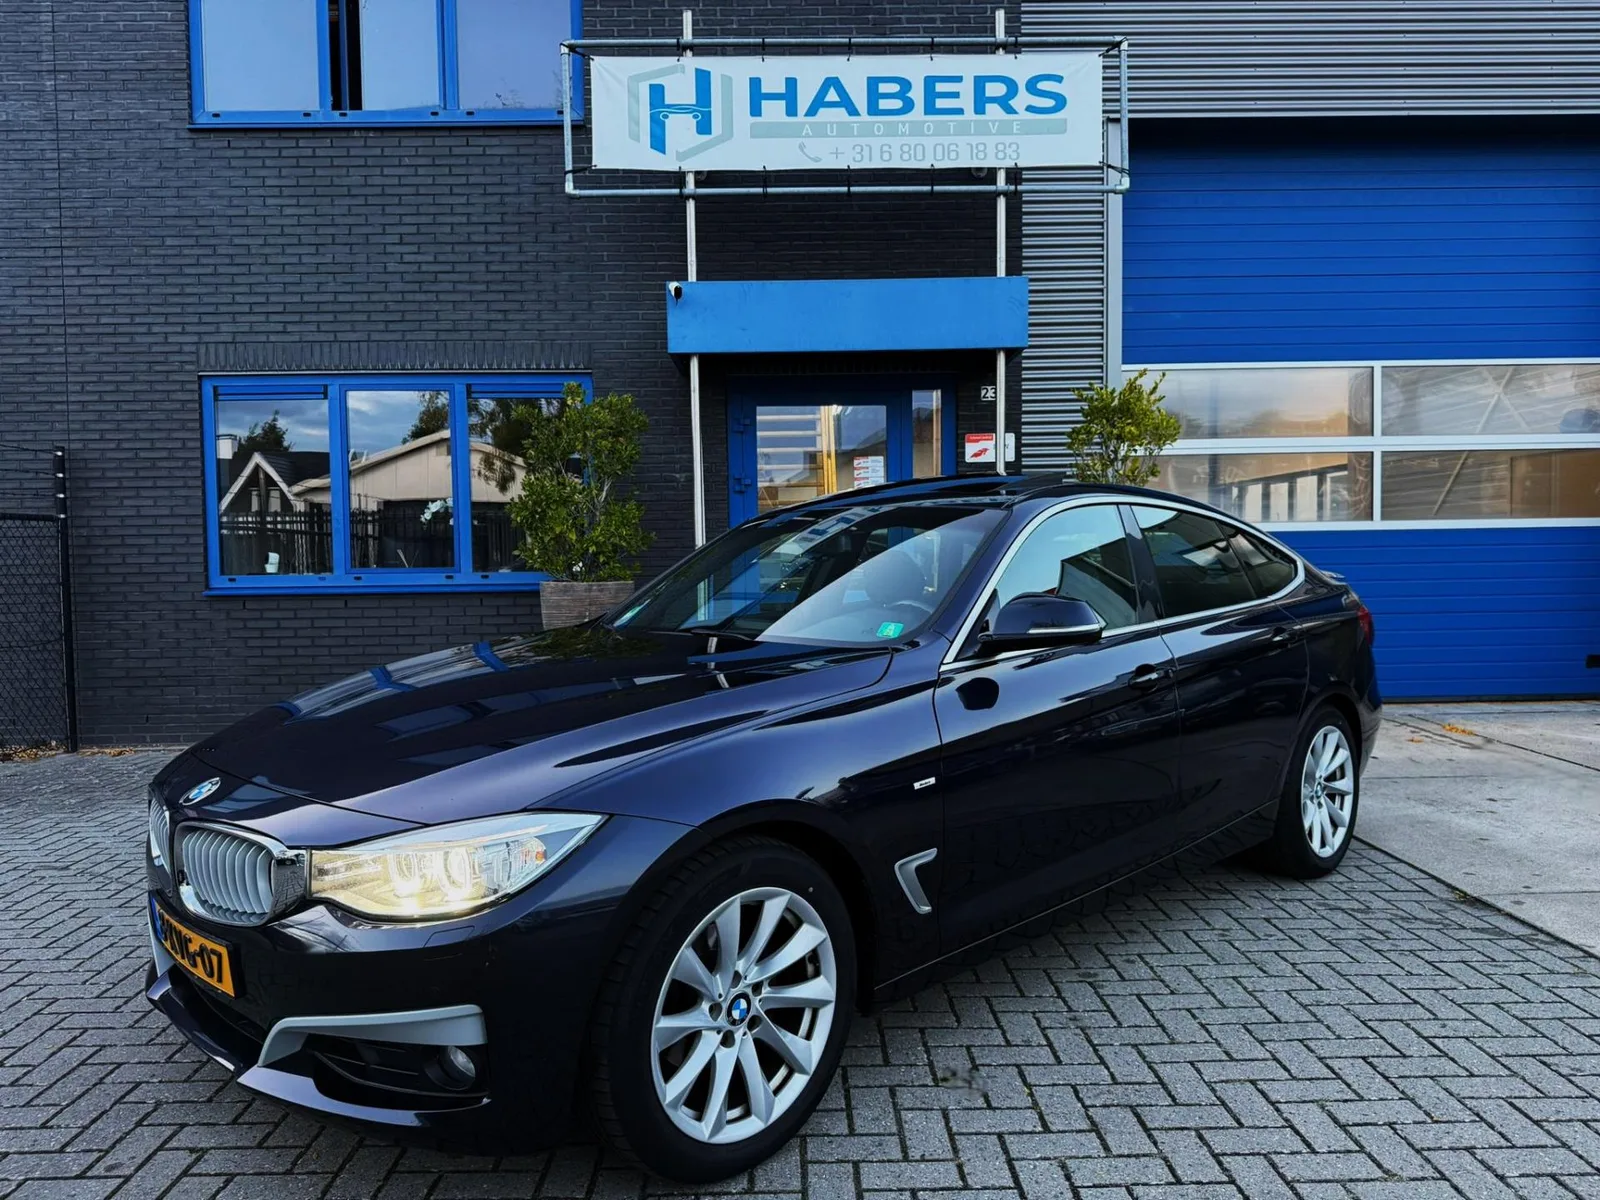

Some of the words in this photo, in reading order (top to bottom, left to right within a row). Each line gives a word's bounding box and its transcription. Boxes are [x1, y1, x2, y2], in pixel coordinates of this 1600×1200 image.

[749, 73, 1068, 117] HABERS
[802, 121, 1021, 136] AUTOMOTIVE
[879, 143, 893, 163] 6
[900, 143, 926, 162] 80
[933, 142, 959, 162] 06
[966, 142, 987, 161] 18
[994, 141, 1021, 161] 83
[982, 387, 997, 399] 23
